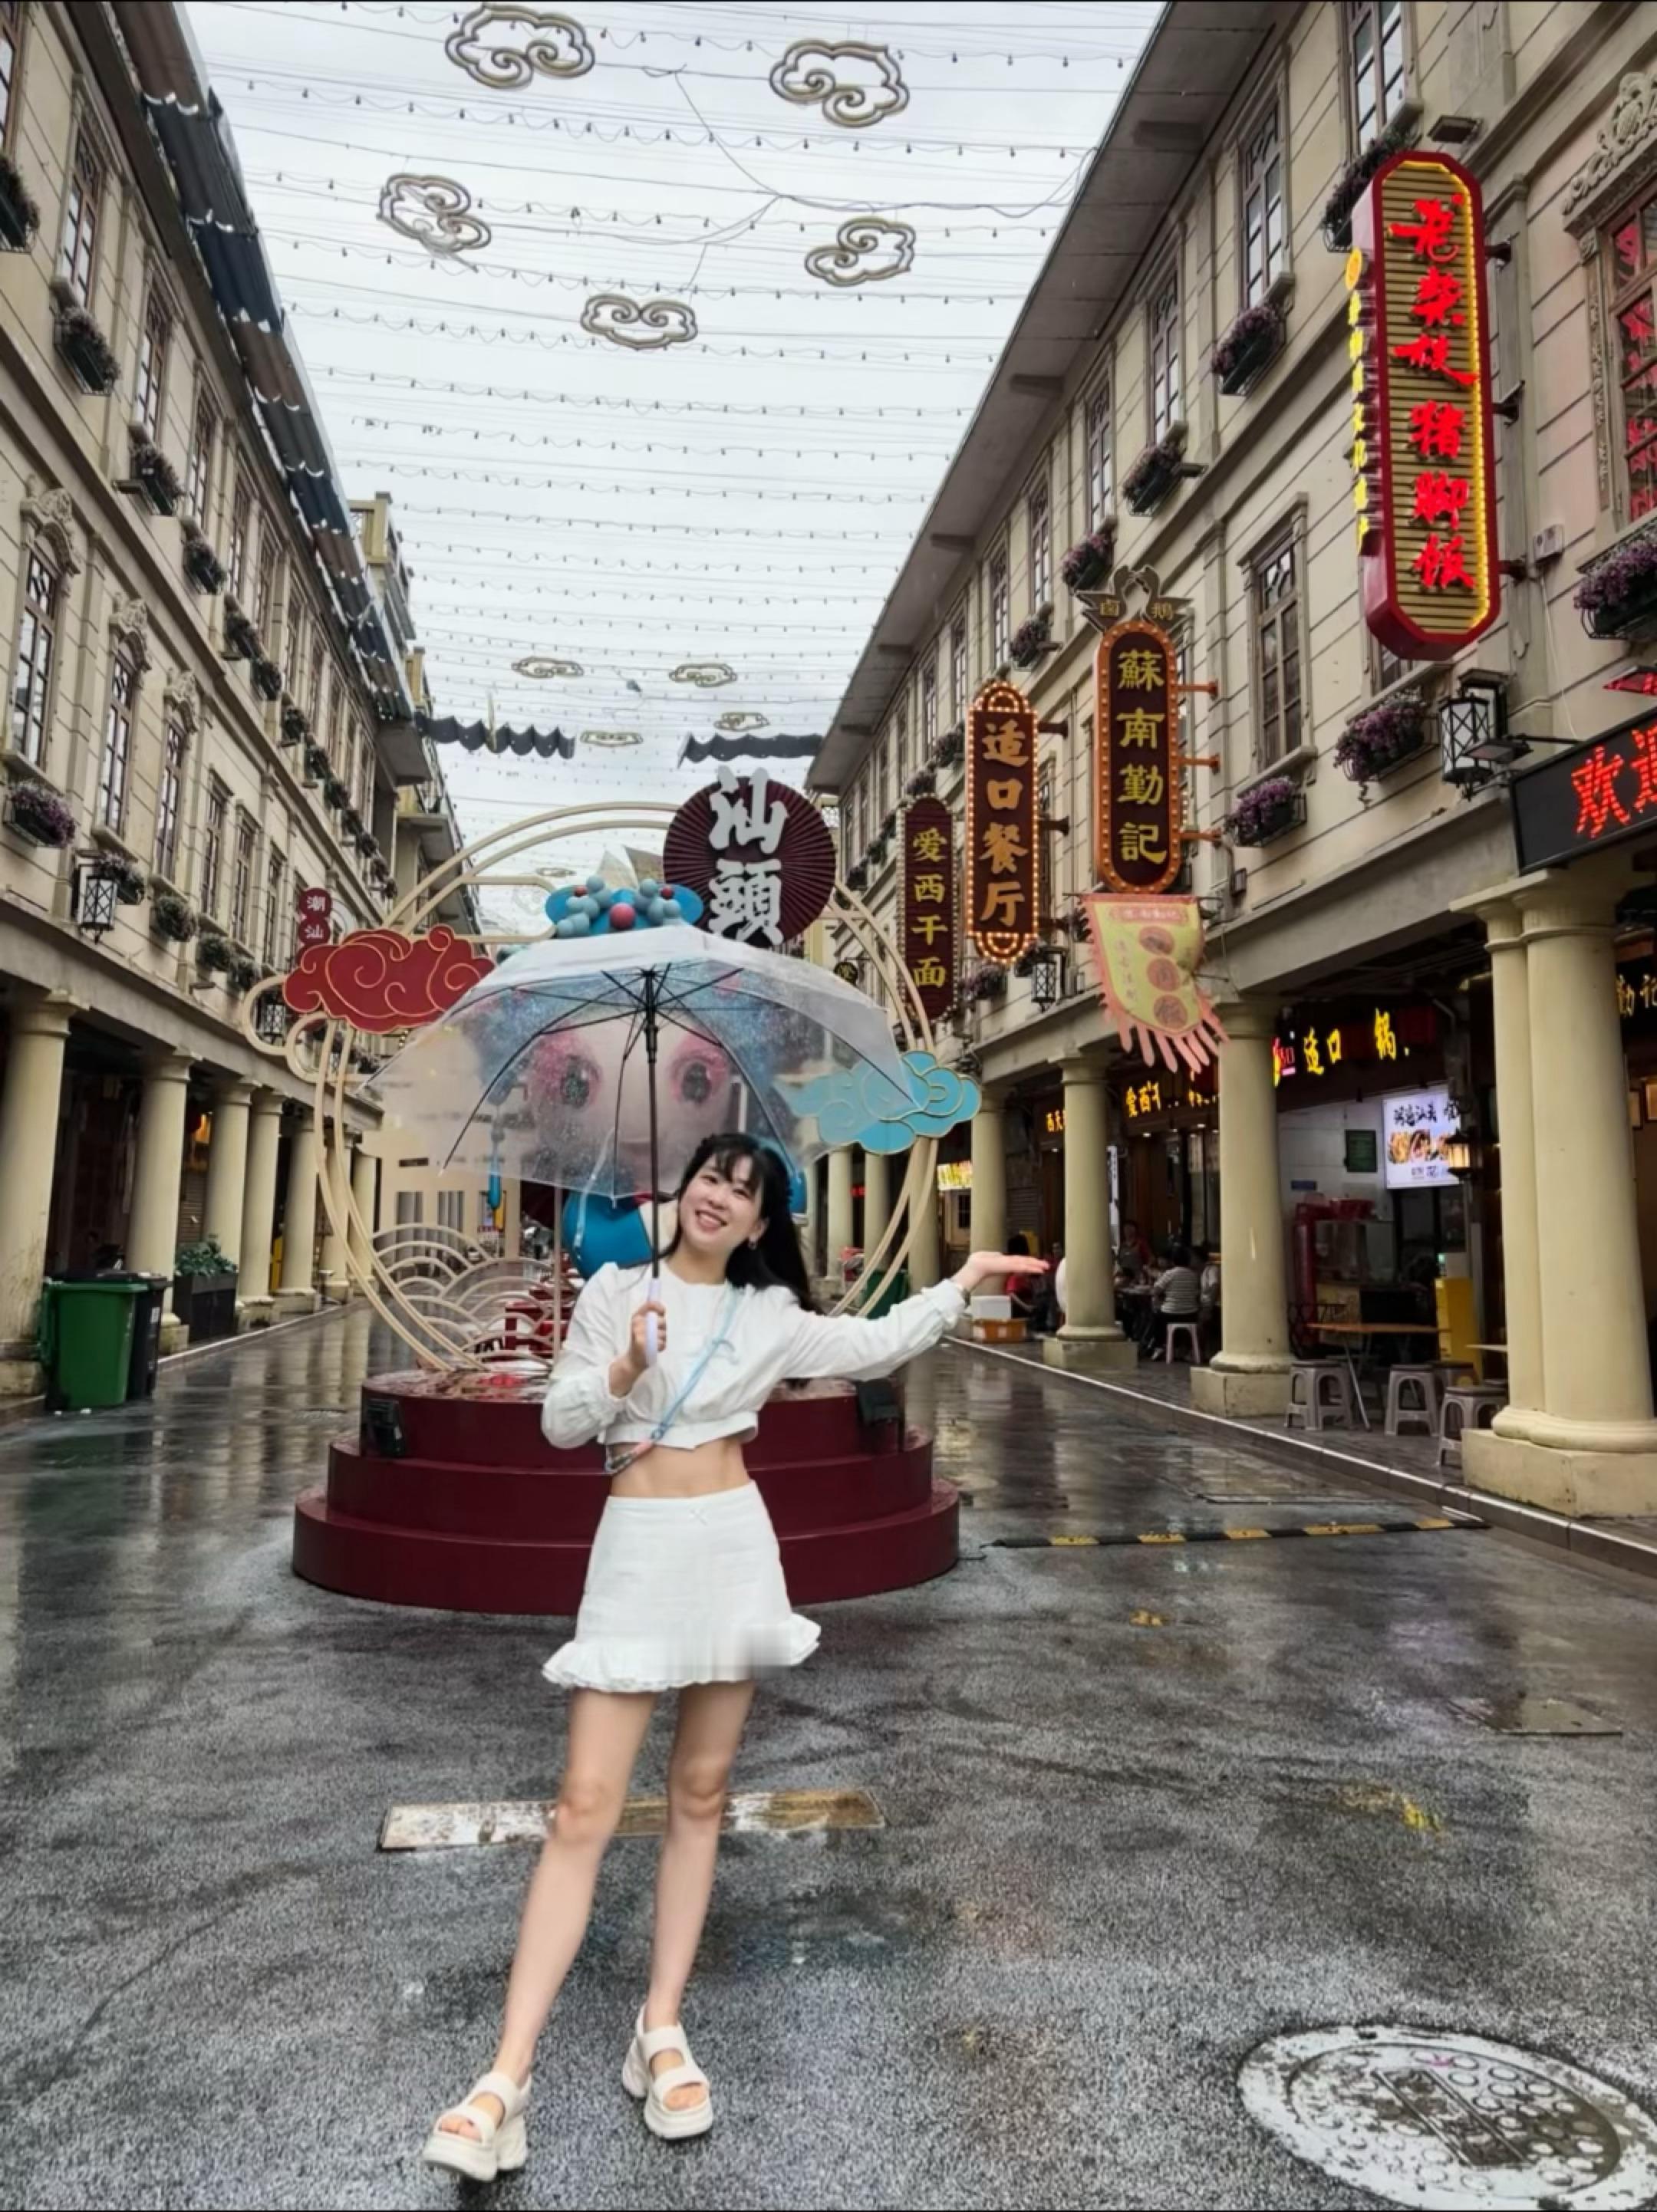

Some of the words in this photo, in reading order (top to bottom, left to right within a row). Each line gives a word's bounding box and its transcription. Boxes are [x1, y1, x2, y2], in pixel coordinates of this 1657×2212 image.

[979, 719, 1029, 927] 适口餐厅
[1115, 649, 1168, 864] 蘇南勤記
[709, 765, 789, 945] 汕頭
[911, 827, 948, 988] 爱西干面
